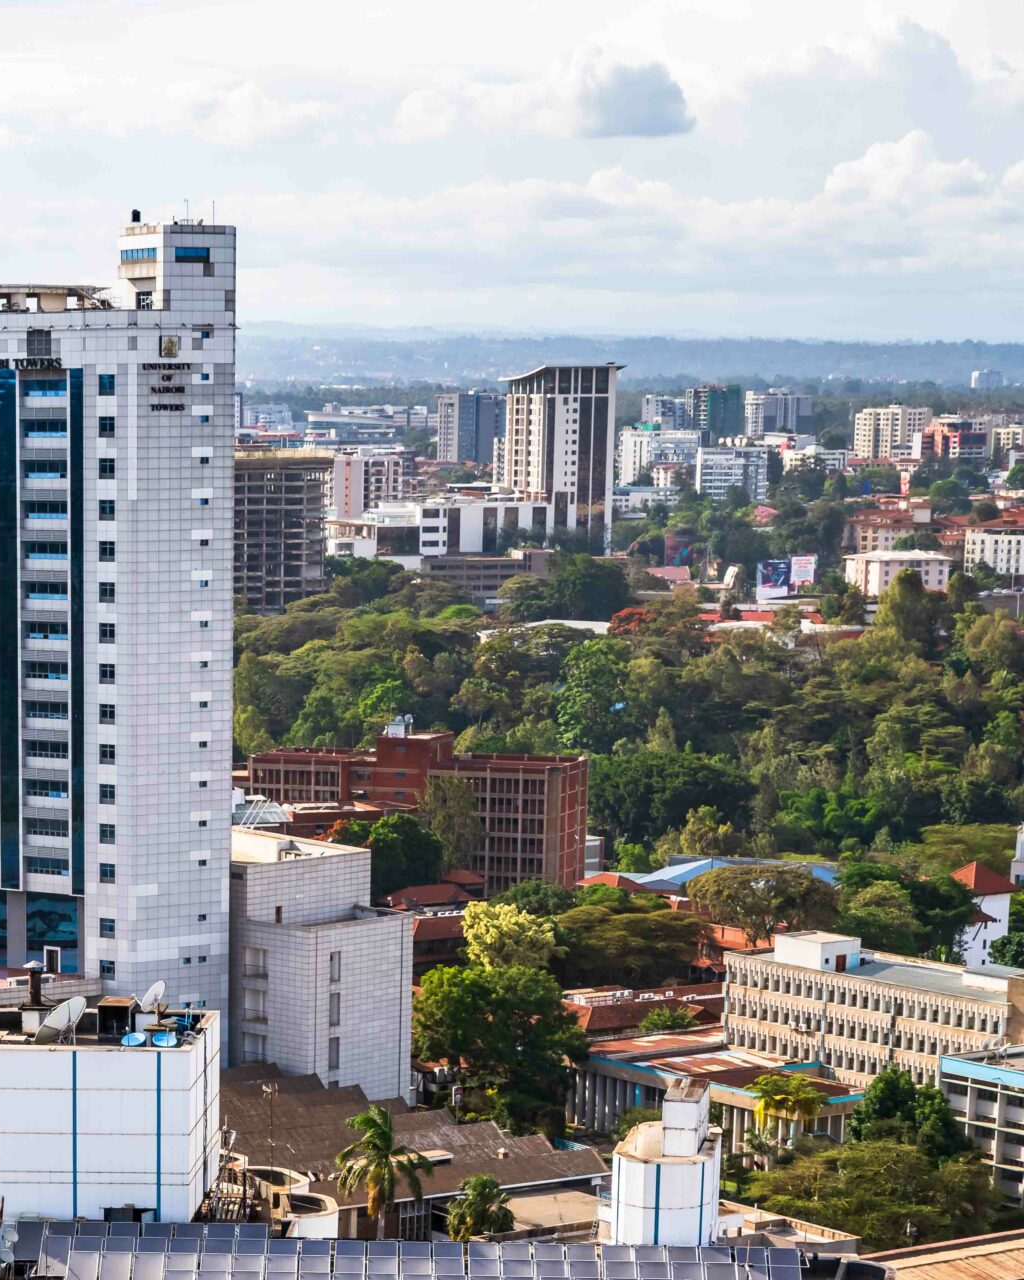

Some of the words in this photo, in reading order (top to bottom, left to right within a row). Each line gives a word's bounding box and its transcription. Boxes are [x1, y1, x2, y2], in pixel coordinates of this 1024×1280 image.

[12, 357, 63, 369] TOWERS
[142, 363, 192, 371] UNIVERSITY
[161, 373, 174, 382] OF
[150, 386, 186, 394] NAIROBI
[150, 403, 186, 412] TOWERS
